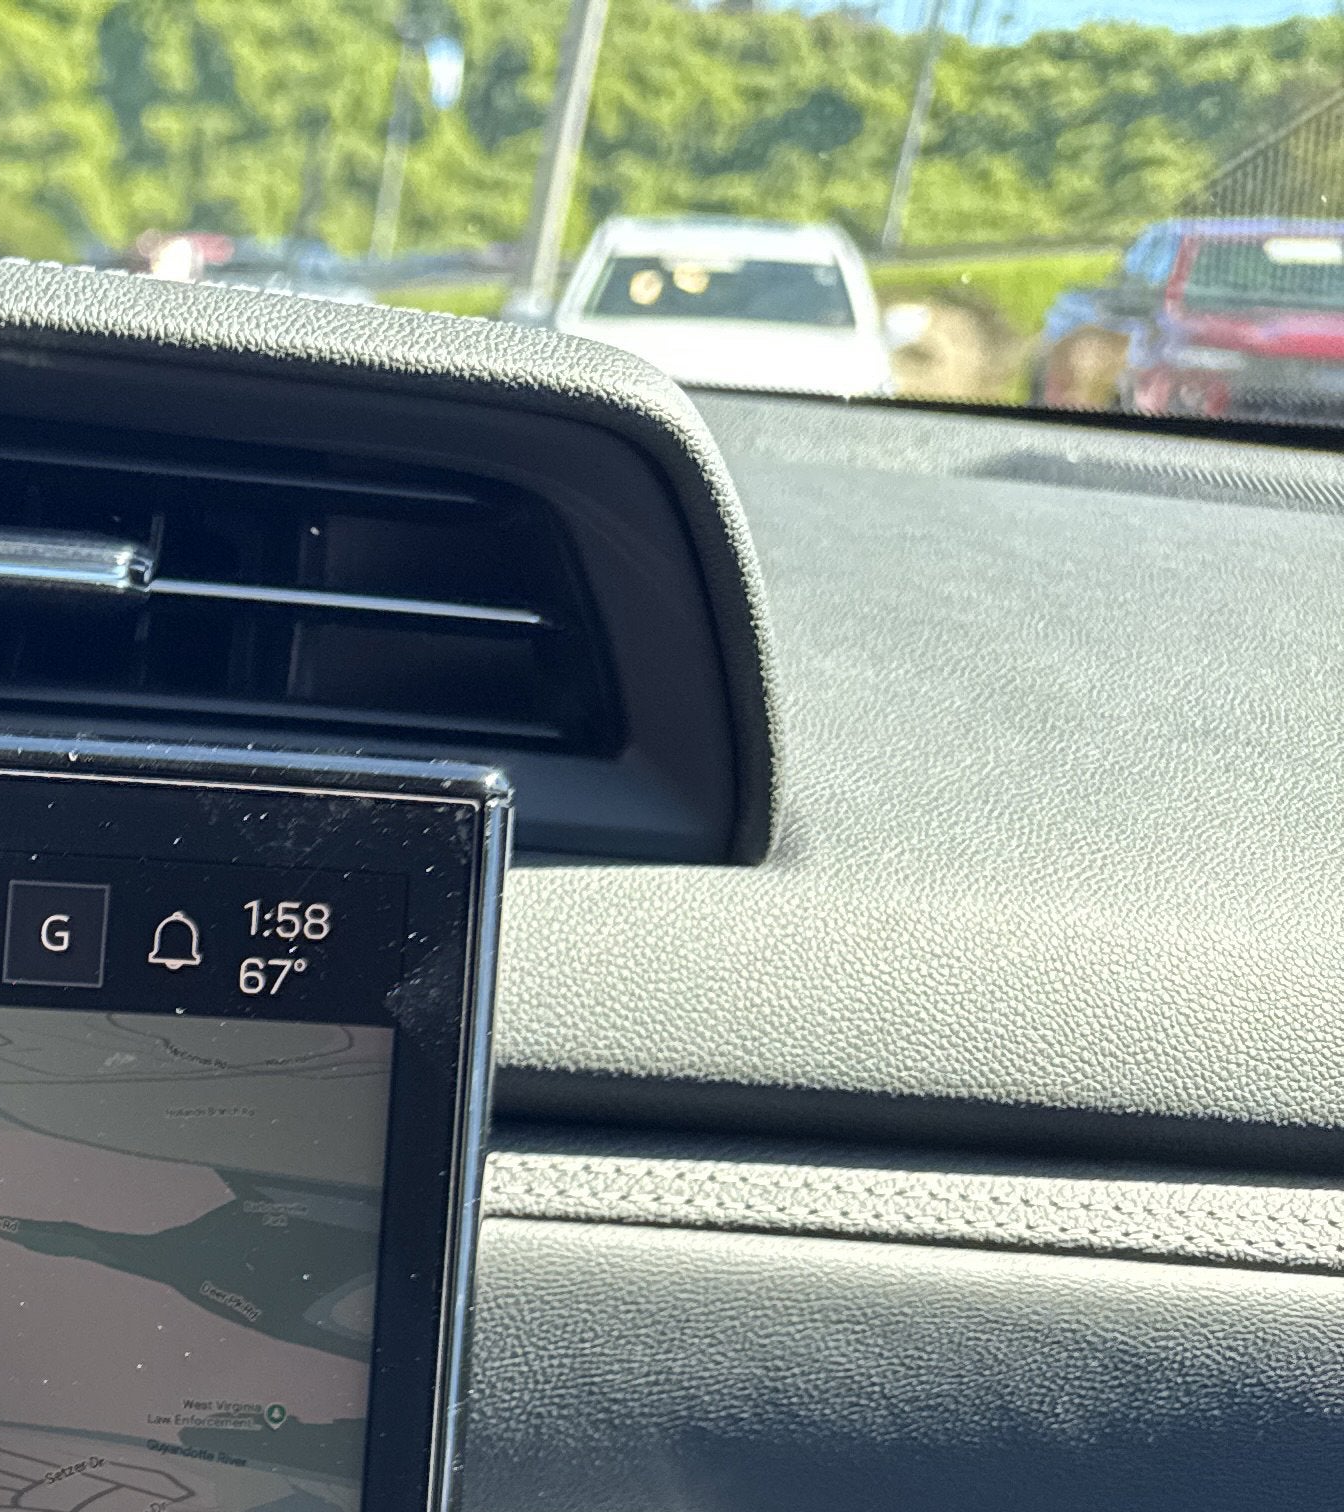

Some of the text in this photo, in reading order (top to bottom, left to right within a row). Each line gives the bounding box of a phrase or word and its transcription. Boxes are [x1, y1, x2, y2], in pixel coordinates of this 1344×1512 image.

[40, 915, 70, 951] G
[243, 901, 331, 940] 1:58
[238, 958, 306, 994] 67°
[182, 1400, 261, 1413] West Virginia
[147, 1415, 251, 1429] Law Enforcement
[44, 1456, 105, 1485] Setzer Dr
[215, 1454, 247, 1467] River
